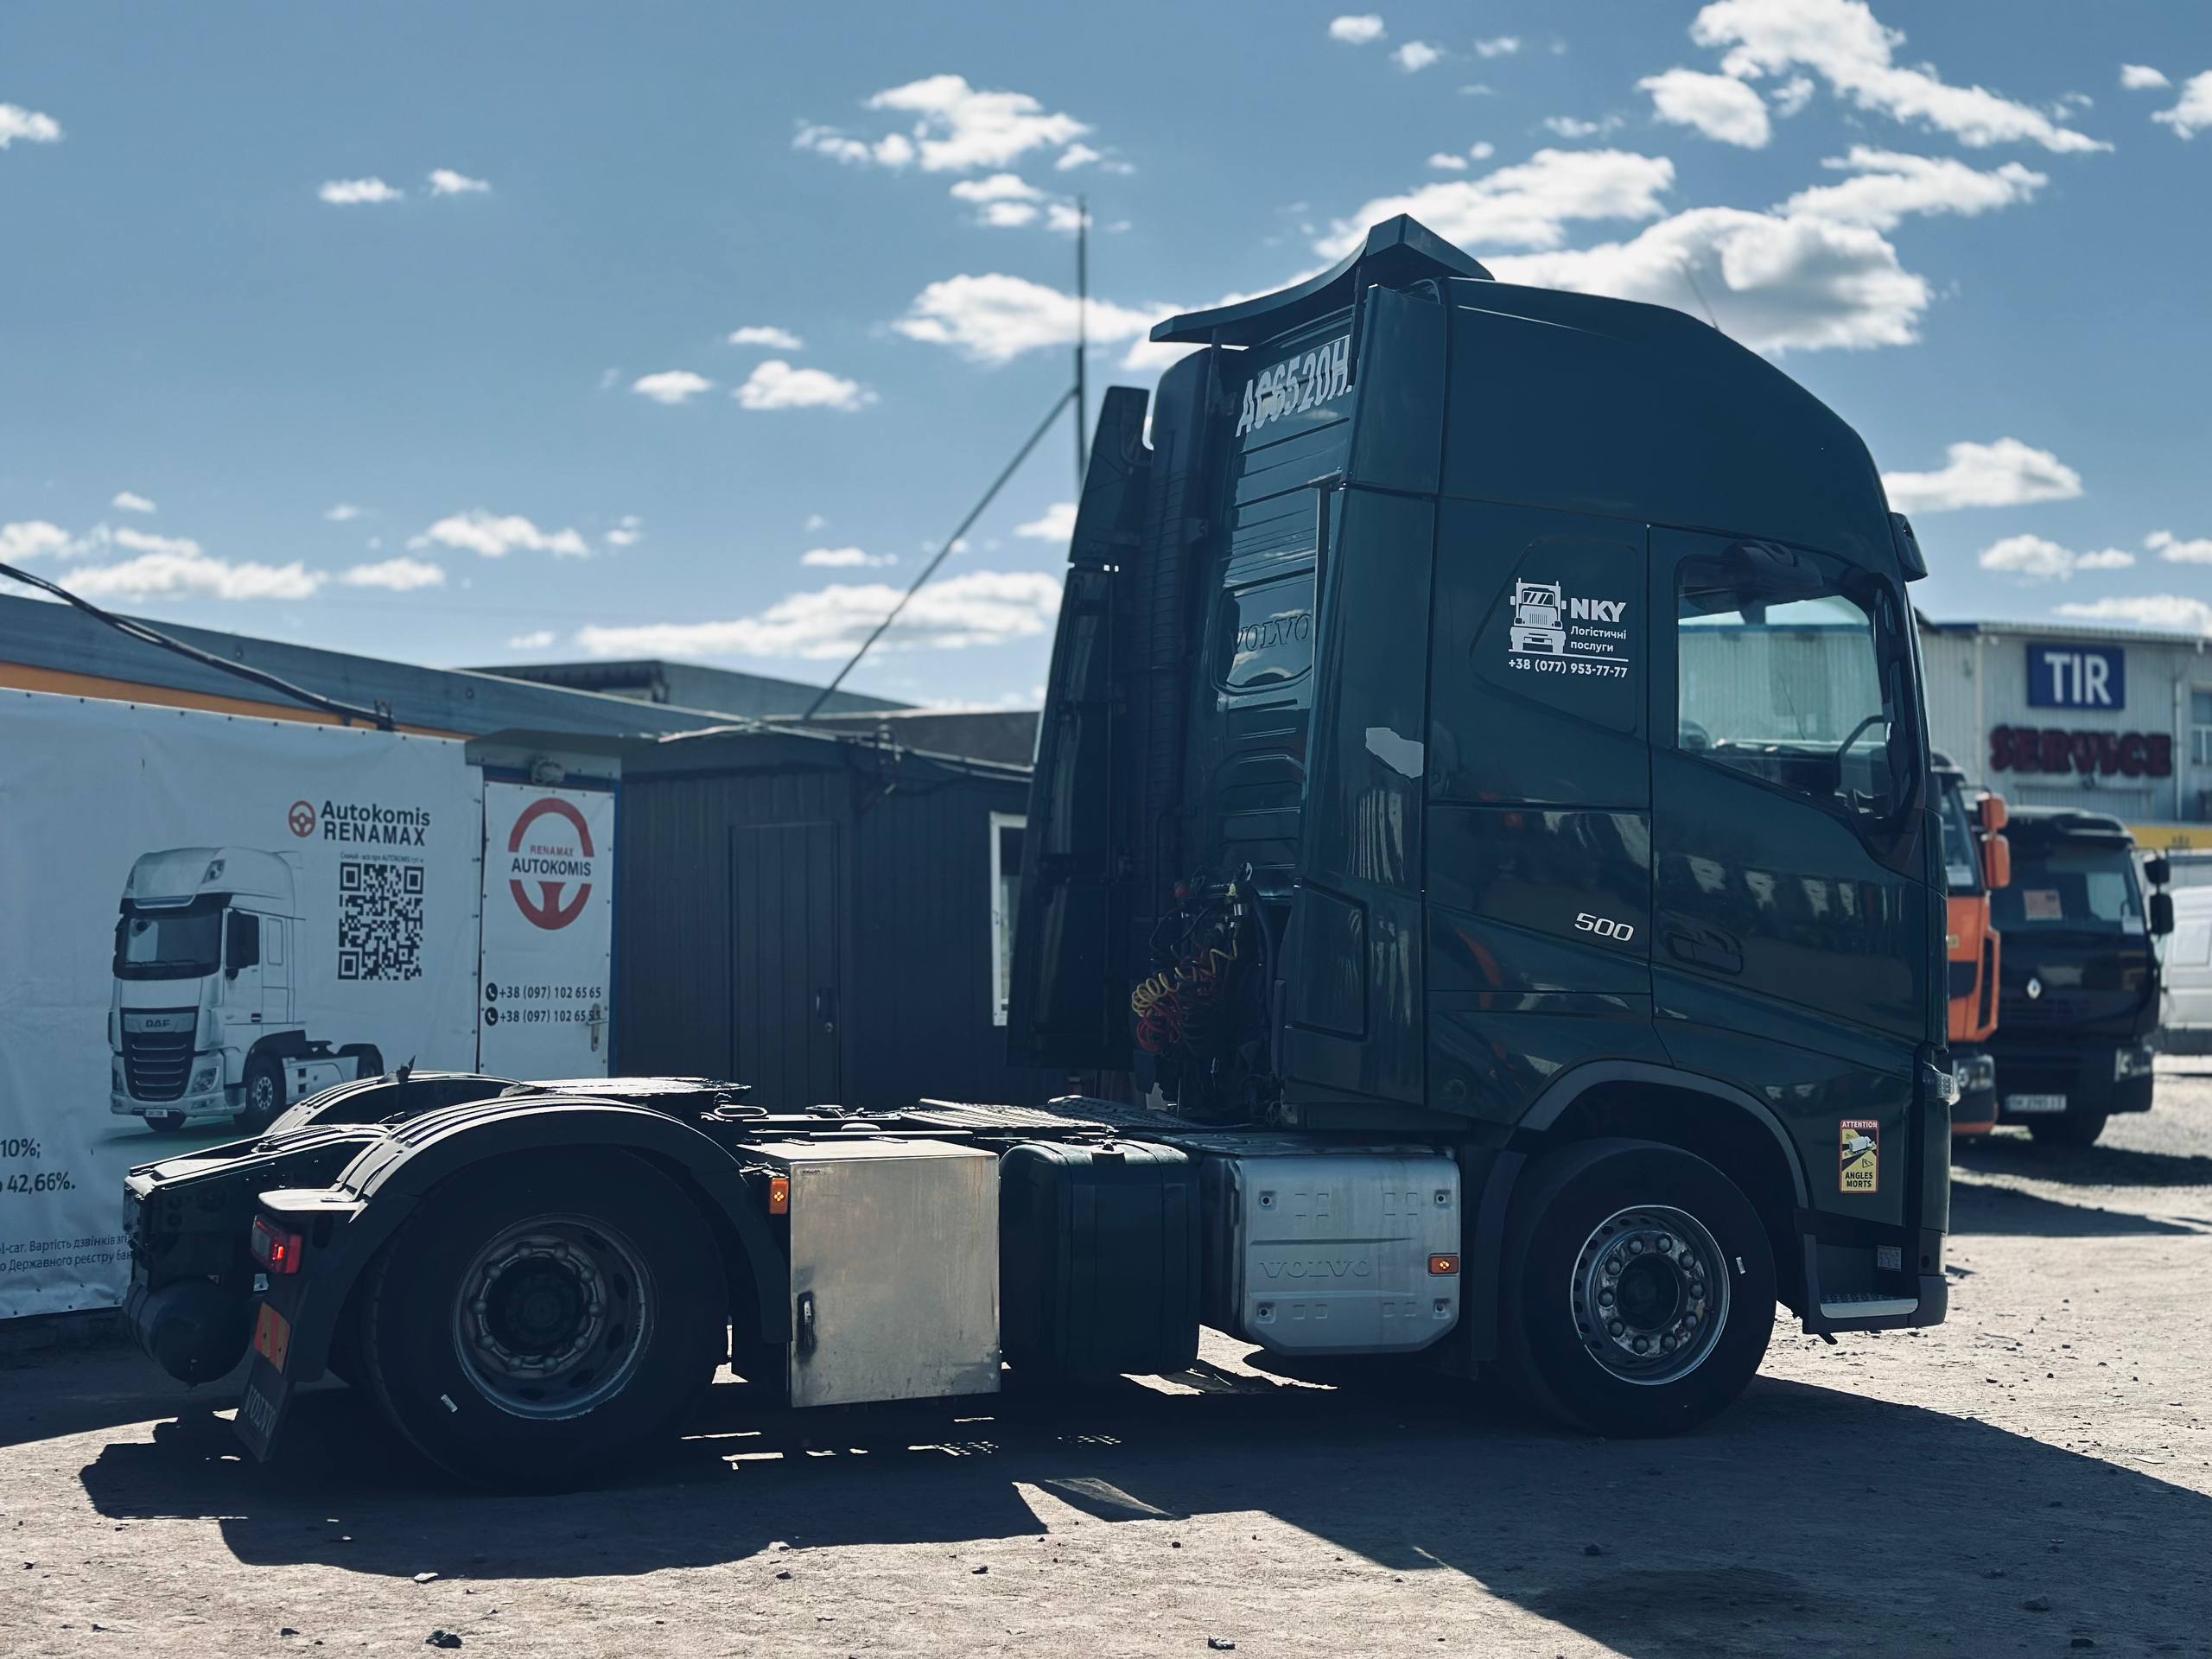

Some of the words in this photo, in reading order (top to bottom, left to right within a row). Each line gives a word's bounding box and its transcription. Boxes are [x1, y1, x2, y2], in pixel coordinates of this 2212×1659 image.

[1570, 597, 1626, 623] NKY
[1570, 626, 1627, 639] Логістичні
[1570, 640, 1614, 654] послуги
[1509, 658, 1531, 671] +38
[1535, 658, 1567, 674] (077)
[1571, 663, 1628, 678] 953-77-77
[2044, 652, 2113, 705] TIR
[1990, 725, 2171, 776] SERVICE
[321, 800, 430, 827] Autokomis
[324, 822, 426, 847] RENAMAX
[530, 844, 575, 857] RENAMAX
[511, 857, 592, 877] AUTOKOMIS
[1574, 912, 1634, 942] 500
[499, 986, 520, 999] +38
[524, 986, 551, 1000] (097)
[555, 986, 573, 999] 102
[575, 986, 587, 999] 65
[589, 986, 601, 999] 65
[499, 1010, 520, 1022] +38
[523, 1009, 550, 1023] (097)
[555, 1010, 572, 1022] 102
[574, 1010, 586, 1022] 65
[7, 1172, 76, 1195] 42,66%.
[0, 1242, 27, 1255] l-car.
[29, 1239, 72, 1254] Вартість
[73, 1235, 115, 1249] дзвінків
[9, 1256, 73, 1273] Державного
[74, 1251, 114, 1268] реєстру
[1258, 1259, 1371, 1279] VOLVO
[244, 1382, 276, 1439] VOLVO
